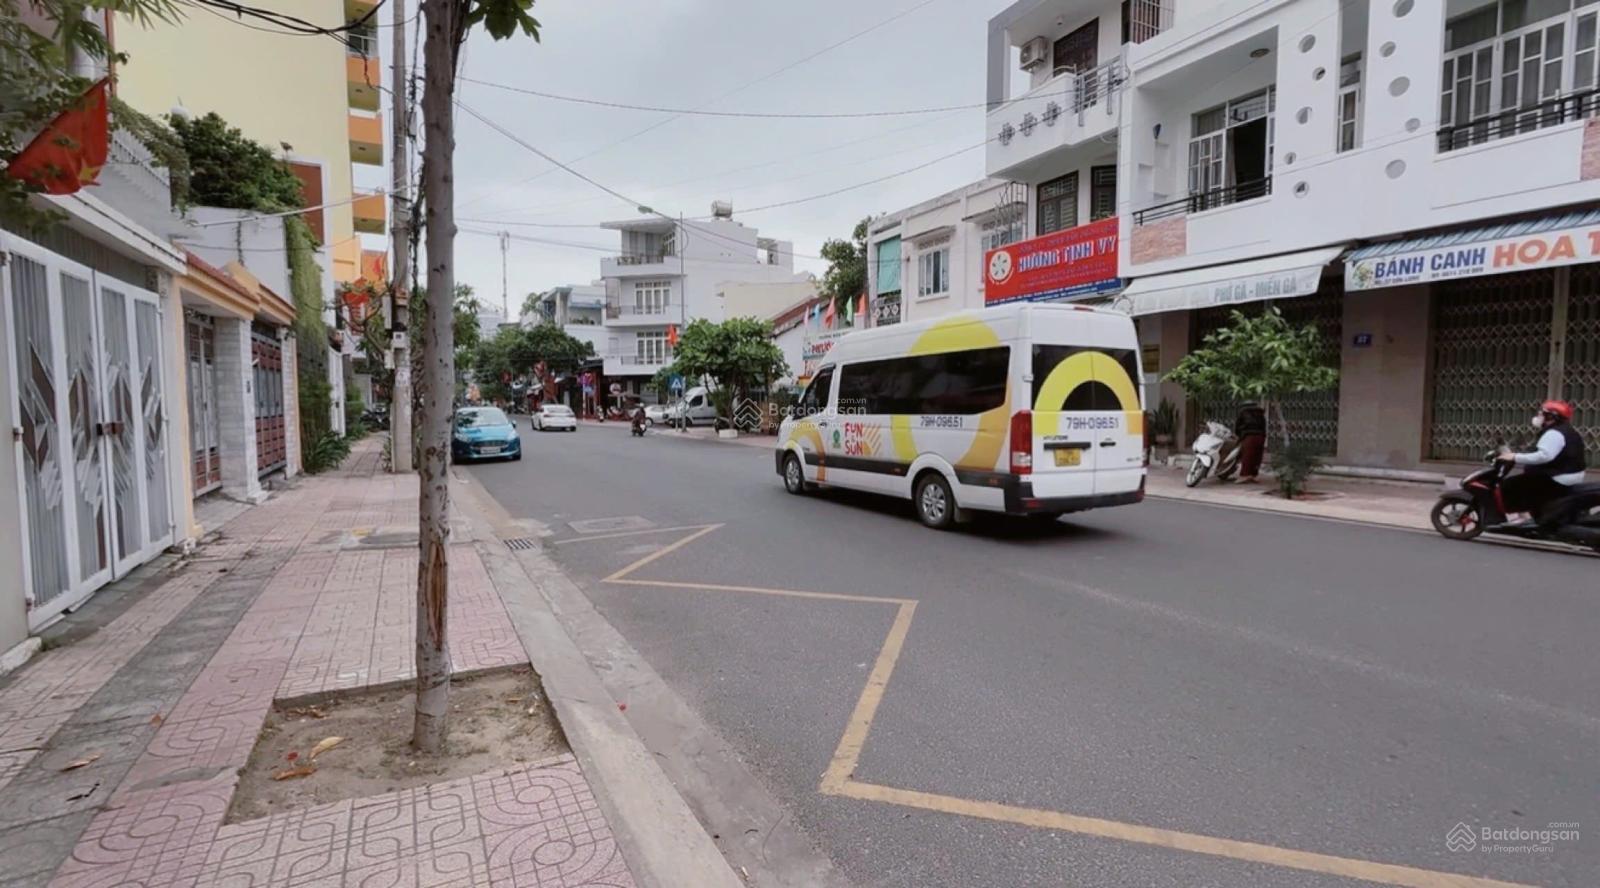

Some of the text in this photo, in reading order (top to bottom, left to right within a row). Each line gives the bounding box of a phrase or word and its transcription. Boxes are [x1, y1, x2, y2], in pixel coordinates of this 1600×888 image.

[1375, 256, 1425, 278] BÁNH
[1431, 247, 1487, 271] CANH
[1493, 235, 1576, 268] HOA
[845, 422, 864, 438] FUN
[845, 440, 864, 455] SUN
